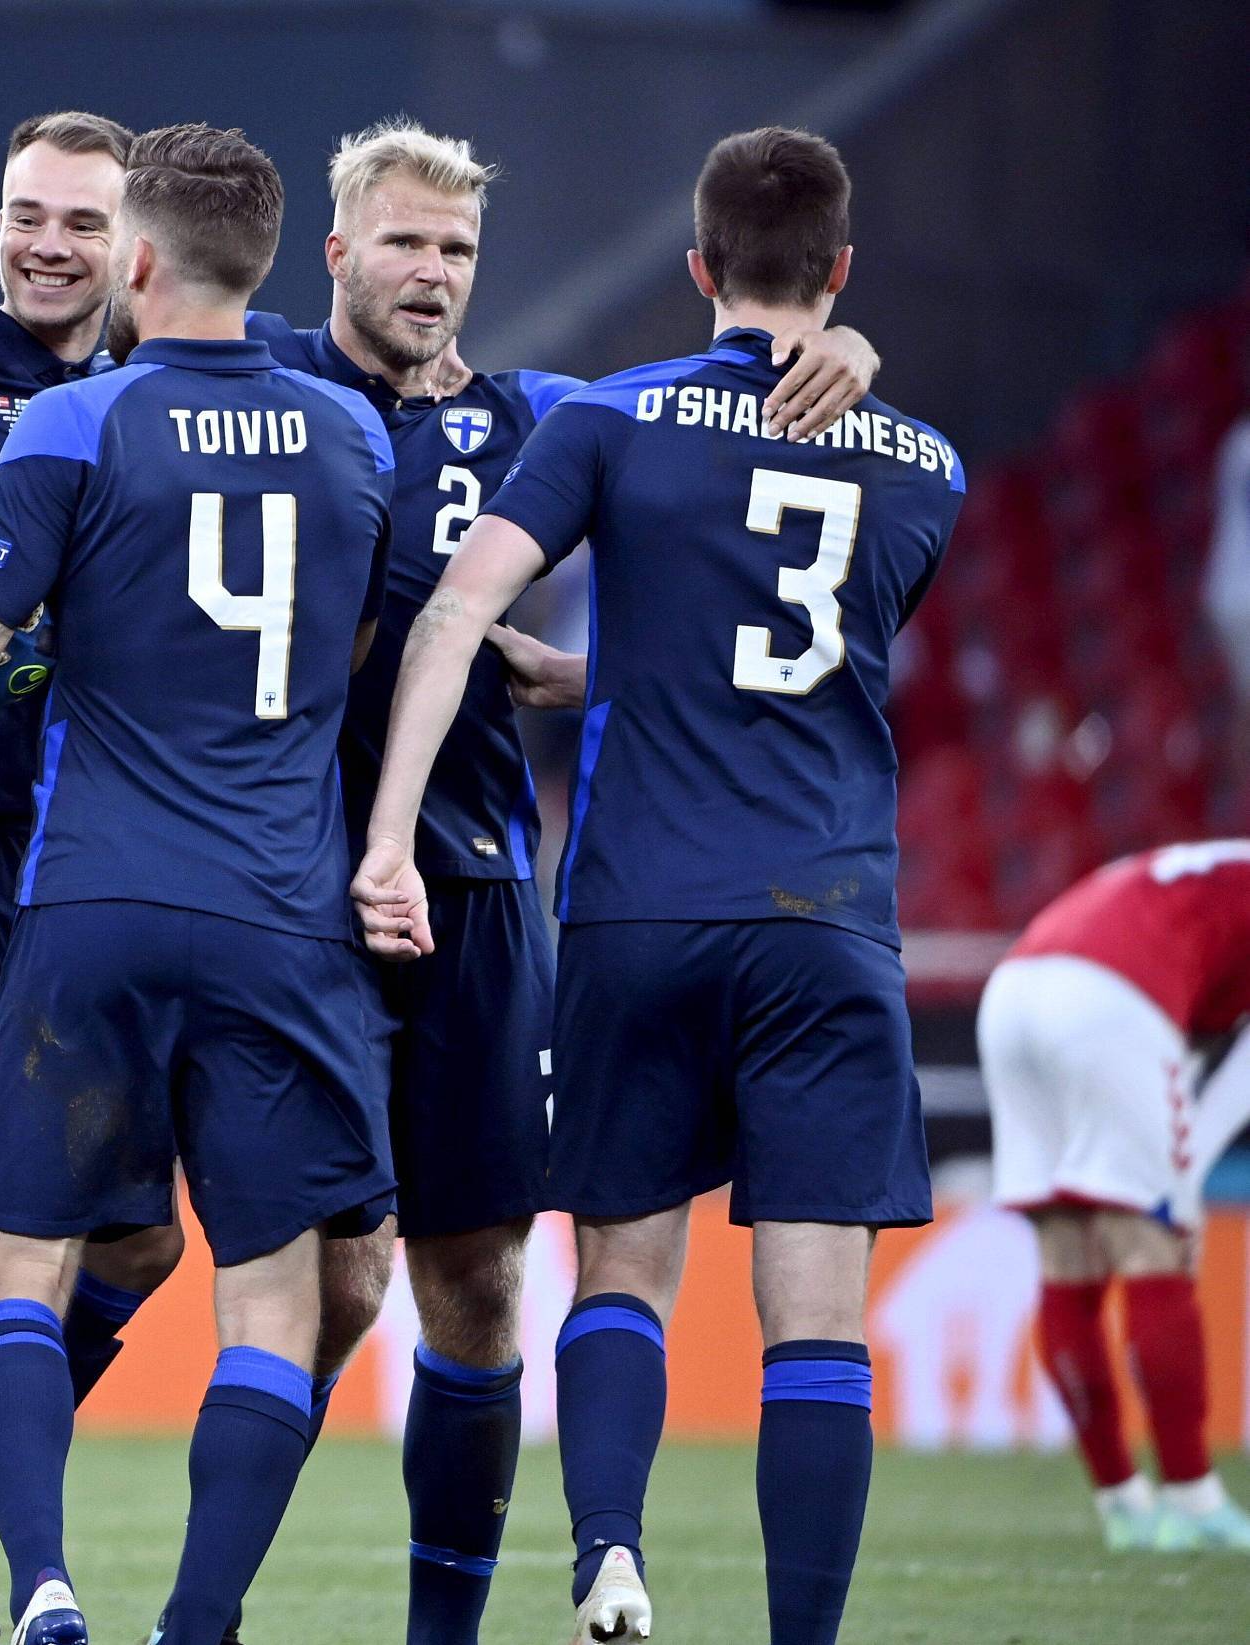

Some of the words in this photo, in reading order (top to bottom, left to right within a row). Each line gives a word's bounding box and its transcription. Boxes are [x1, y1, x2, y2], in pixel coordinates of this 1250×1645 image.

[169, 409, 307, 455] TOIVIO
[432, 464, 481, 554] 2
[187, 492, 297, 720] 4
[733, 468, 862, 696] 3
